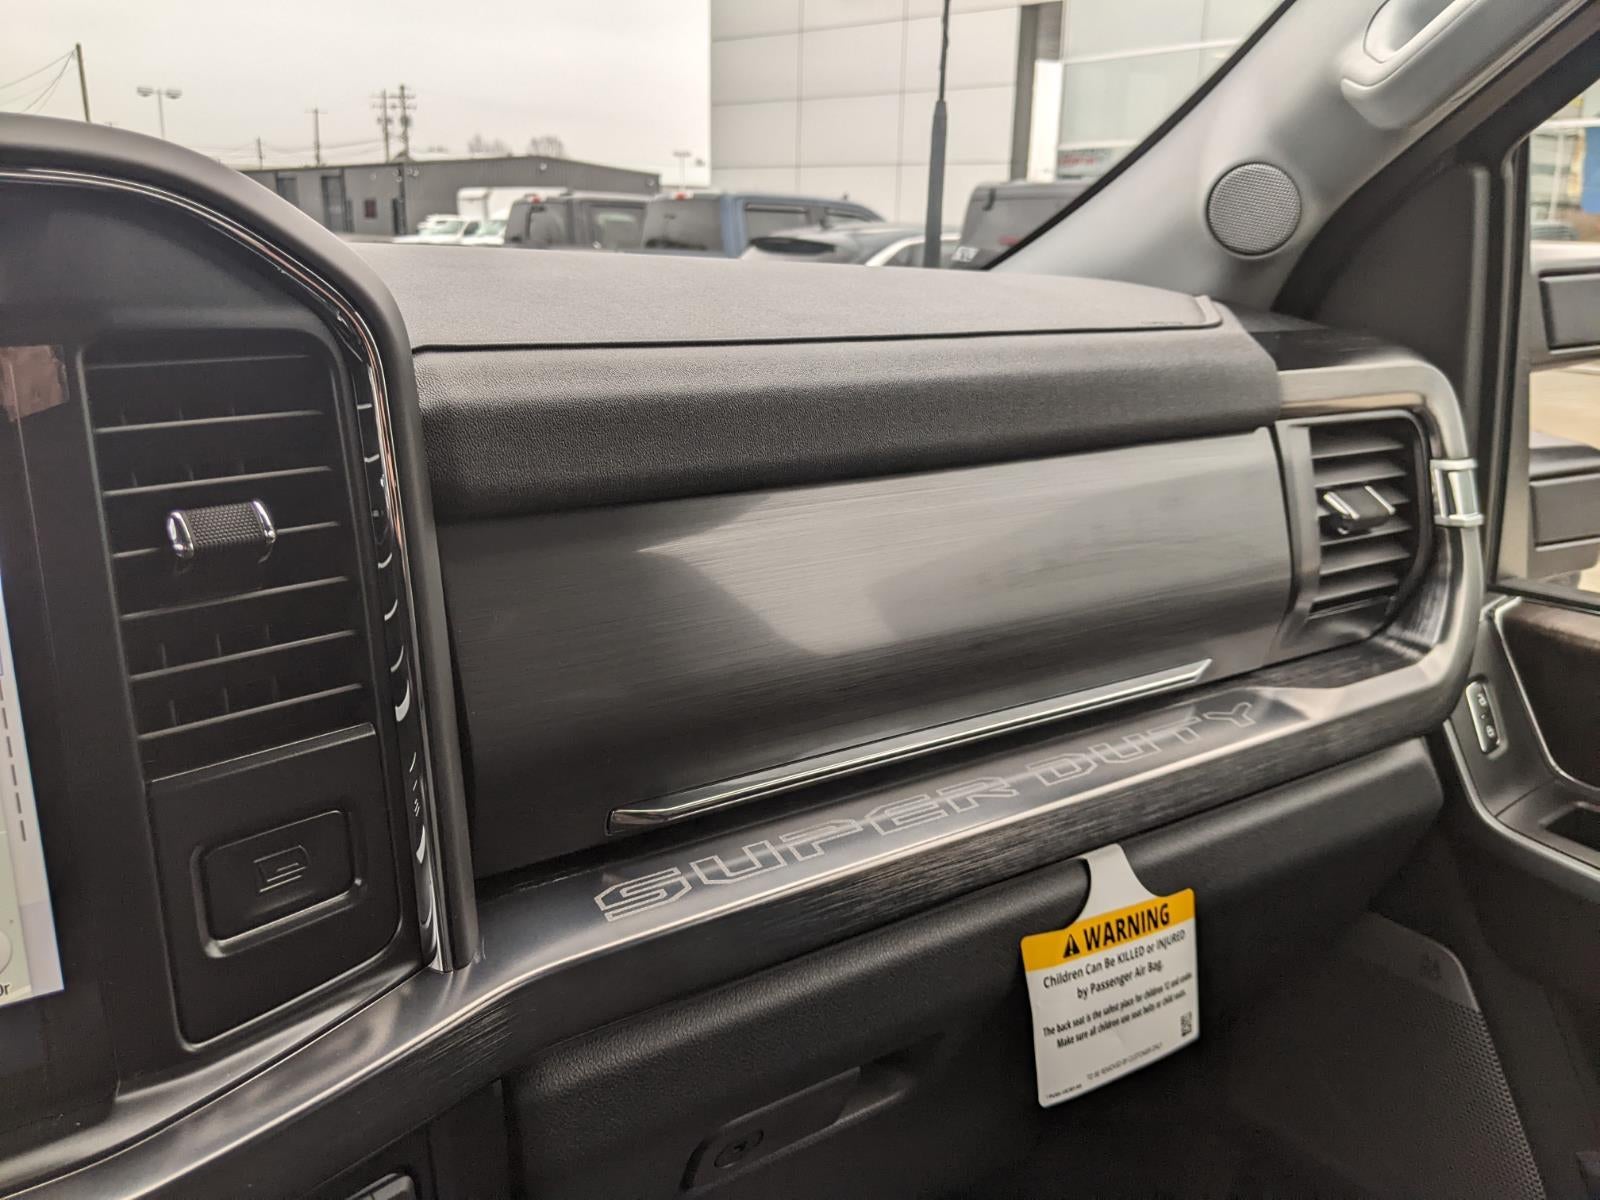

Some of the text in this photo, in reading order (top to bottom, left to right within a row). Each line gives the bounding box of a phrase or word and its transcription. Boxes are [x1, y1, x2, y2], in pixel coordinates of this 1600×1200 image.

[594, 699, 1256, 922] SUPER DUTY
[1082, 902, 1170, 952] WARNING
[1043, 928, 1186, 989] Children Can Be KILLED or INJURED
[1076, 986, 1089, 1001] by
[1090, 971, 1133, 996] Passenger
[1134, 964, 1146, 978] Air
[1043, 1025, 1056, 1037] The
[1056, 1019, 1071, 1034] back
[1072, 1015, 1086, 1028] seat
[1092, 1009, 1102, 1020] the
[1120, 997, 1134, 1012] place
[1143, 985, 1163, 1000] children
[1056, 1035, 1075, 1049] Make
[1076, 1031, 1089, 1042] sure
[1089, 1025, 1097, 1037] all
[1097, 1018, 1120, 1033] children
